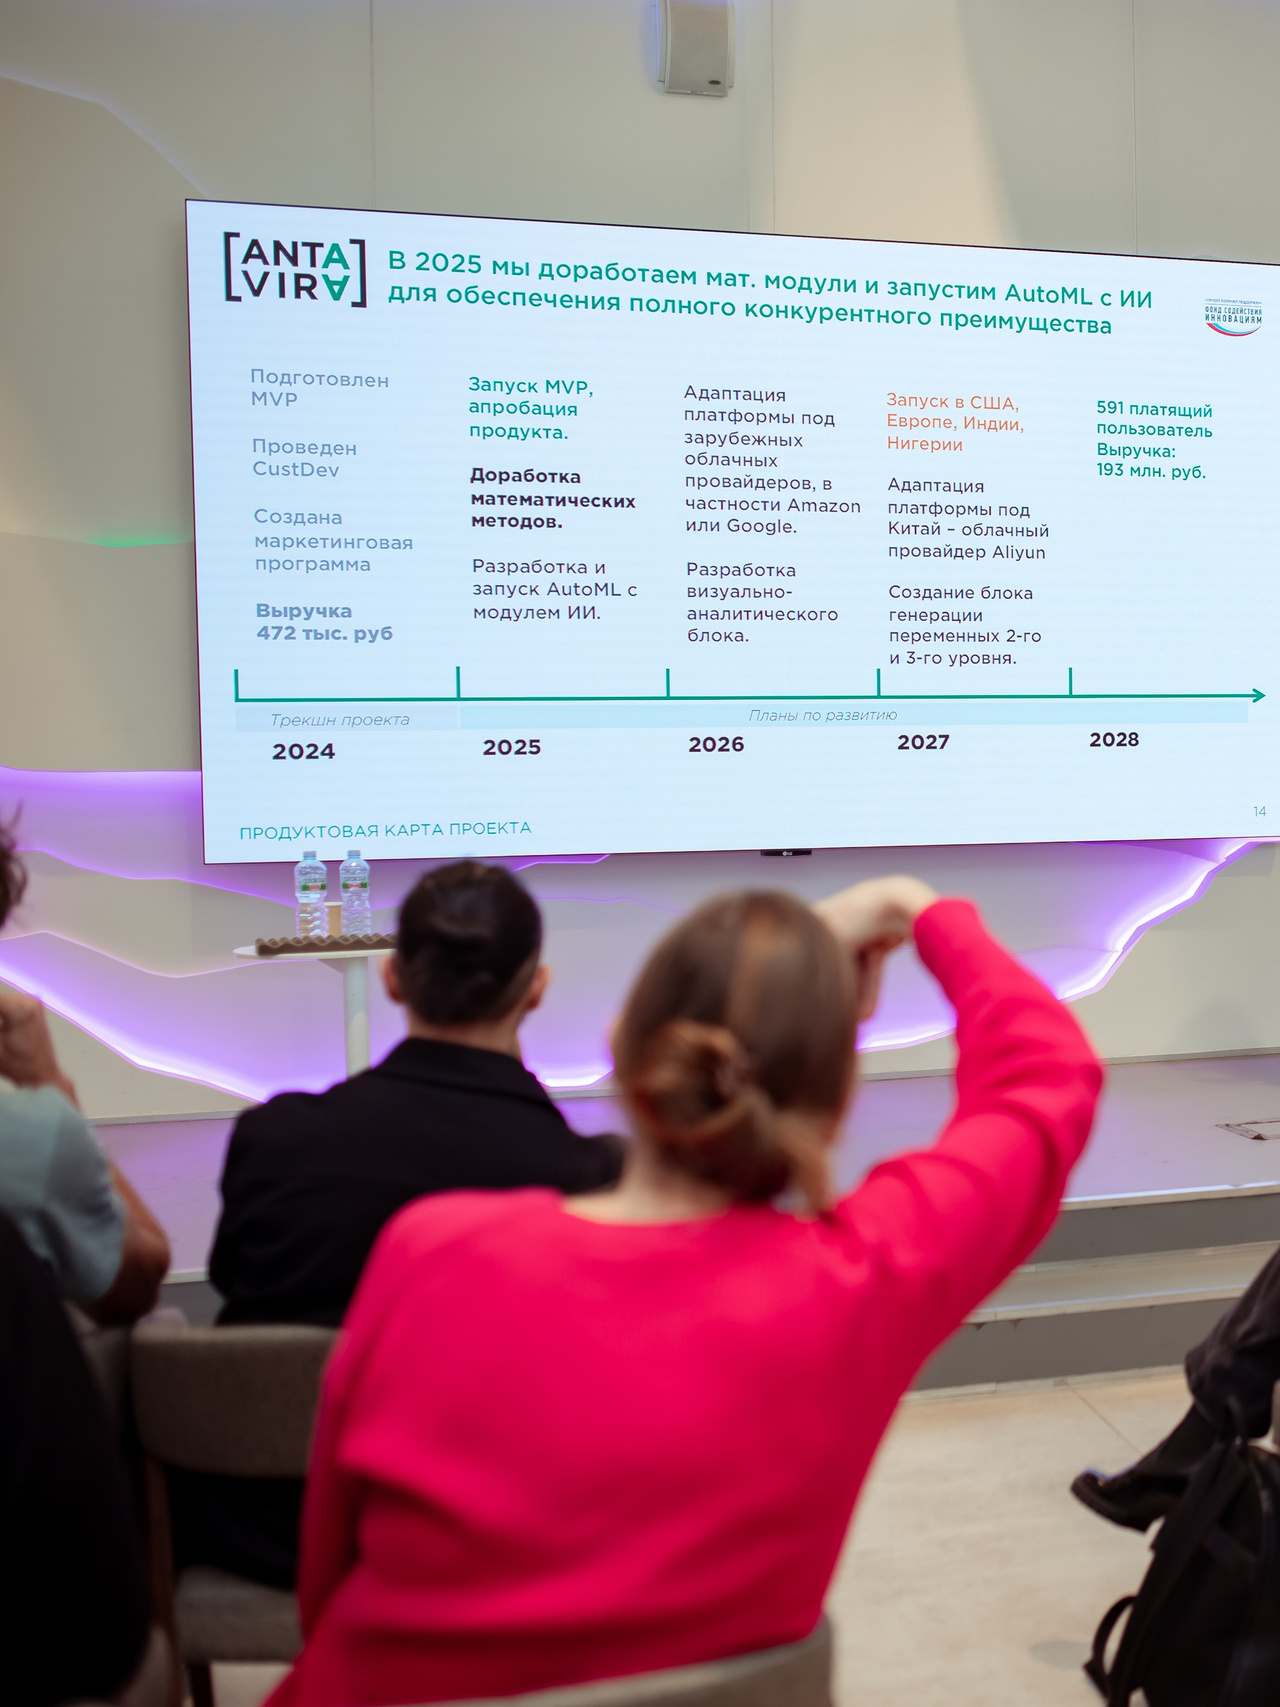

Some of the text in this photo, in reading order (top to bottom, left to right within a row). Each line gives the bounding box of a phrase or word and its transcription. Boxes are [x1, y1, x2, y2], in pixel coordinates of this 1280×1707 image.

[389, 250, 1151, 308] В 2025 мы доработаем мат. модули и запустим AutoML с ИИ
[388, 285, 1111, 334] для обеспечения полного конкурентного преимущества
[1204, 306, 1262, 315] ФОНД СОДЕЙСТВИЯ
[1205, 314, 1262, 324] ИННОВАЦИЯМ
[251, 369, 388, 387] Подготовлен
[469, 377, 592, 397] Запуск MVP,
[684, 385, 785, 403] Адаптация
[252, 391, 297, 406] MVP
[887, 392, 1018, 412] Запуск в США,
[469, 400, 577, 417] апробация
[1097, 400, 1212, 419] 591 платящий
[685, 409, 835, 427] платформы под
[888, 414, 1023, 433] Европе, Индии,
[470, 426, 567, 441] продукта.
[1098, 424, 1212, 437] пользователь
[685, 432, 802, 447] зарубежных
[888, 436, 962, 453] Нигерии
[253, 439, 356, 457] Проведен
[1098, 442, 1175, 459] Выручка:
[685, 452, 777, 467] облачных
[253, 461, 339, 477] CustDev
[470, 468, 580, 484] Доработка
[1097, 463, 1205, 480] 193 млн. руб.
[686, 475, 832, 492] провайдеров, в
[888, 478, 983, 494] Адаптация
[471, 494, 635, 508] математических
[686, 499, 860, 512] частности Amazon
[254, 509, 342, 526] Создана
[889, 502, 1030, 518] платформы под
[472, 516, 562, 529] методов.
[687, 519, 796, 535] или Google.
[889, 522, 940, 535] Китай
[962, 523, 1048, 537] облачный
[255, 537, 412, 550] маркетинговая
[889, 544, 1045, 561] провайдер Aliyun
[256, 559, 370, 573] программа
[473, 559, 605, 575] Разработка и
[687, 562, 795, 579] Разработка
[473, 582, 637, 598] запуск AutoML с
[688, 587, 792, 600] визуально-
[889, 585, 1032, 600] Создание блока
[256, 603, 352, 620] Выручка
[474, 606, 600, 622] модулем ИИ.
[687, 610, 838, 621] аналитического
[890, 611, 982, 624] генерации
[257, 626, 392, 643] 472 тыс. руб
[688, 628, 748, 642] блока.
[890, 629, 1041, 644] переменных 2-го
[891, 651, 1016, 667] и 3-го уровня.
[272, 714, 410, 728] Трекшн проекта
[749, 710, 897, 723] Планы по развитию
[483, 739, 540, 755] 2025
[689, 736, 744, 752] 2026
[898, 735, 949, 750] 2027
[1090, 732, 1139, 747] 2028
[272, 743, 335, 760] 2024
[1254, 806, 1266, 816] 14
[240, 822, 531, 841] ПРОДУКТОВАЯ КАРТА ПРОЕКТА
